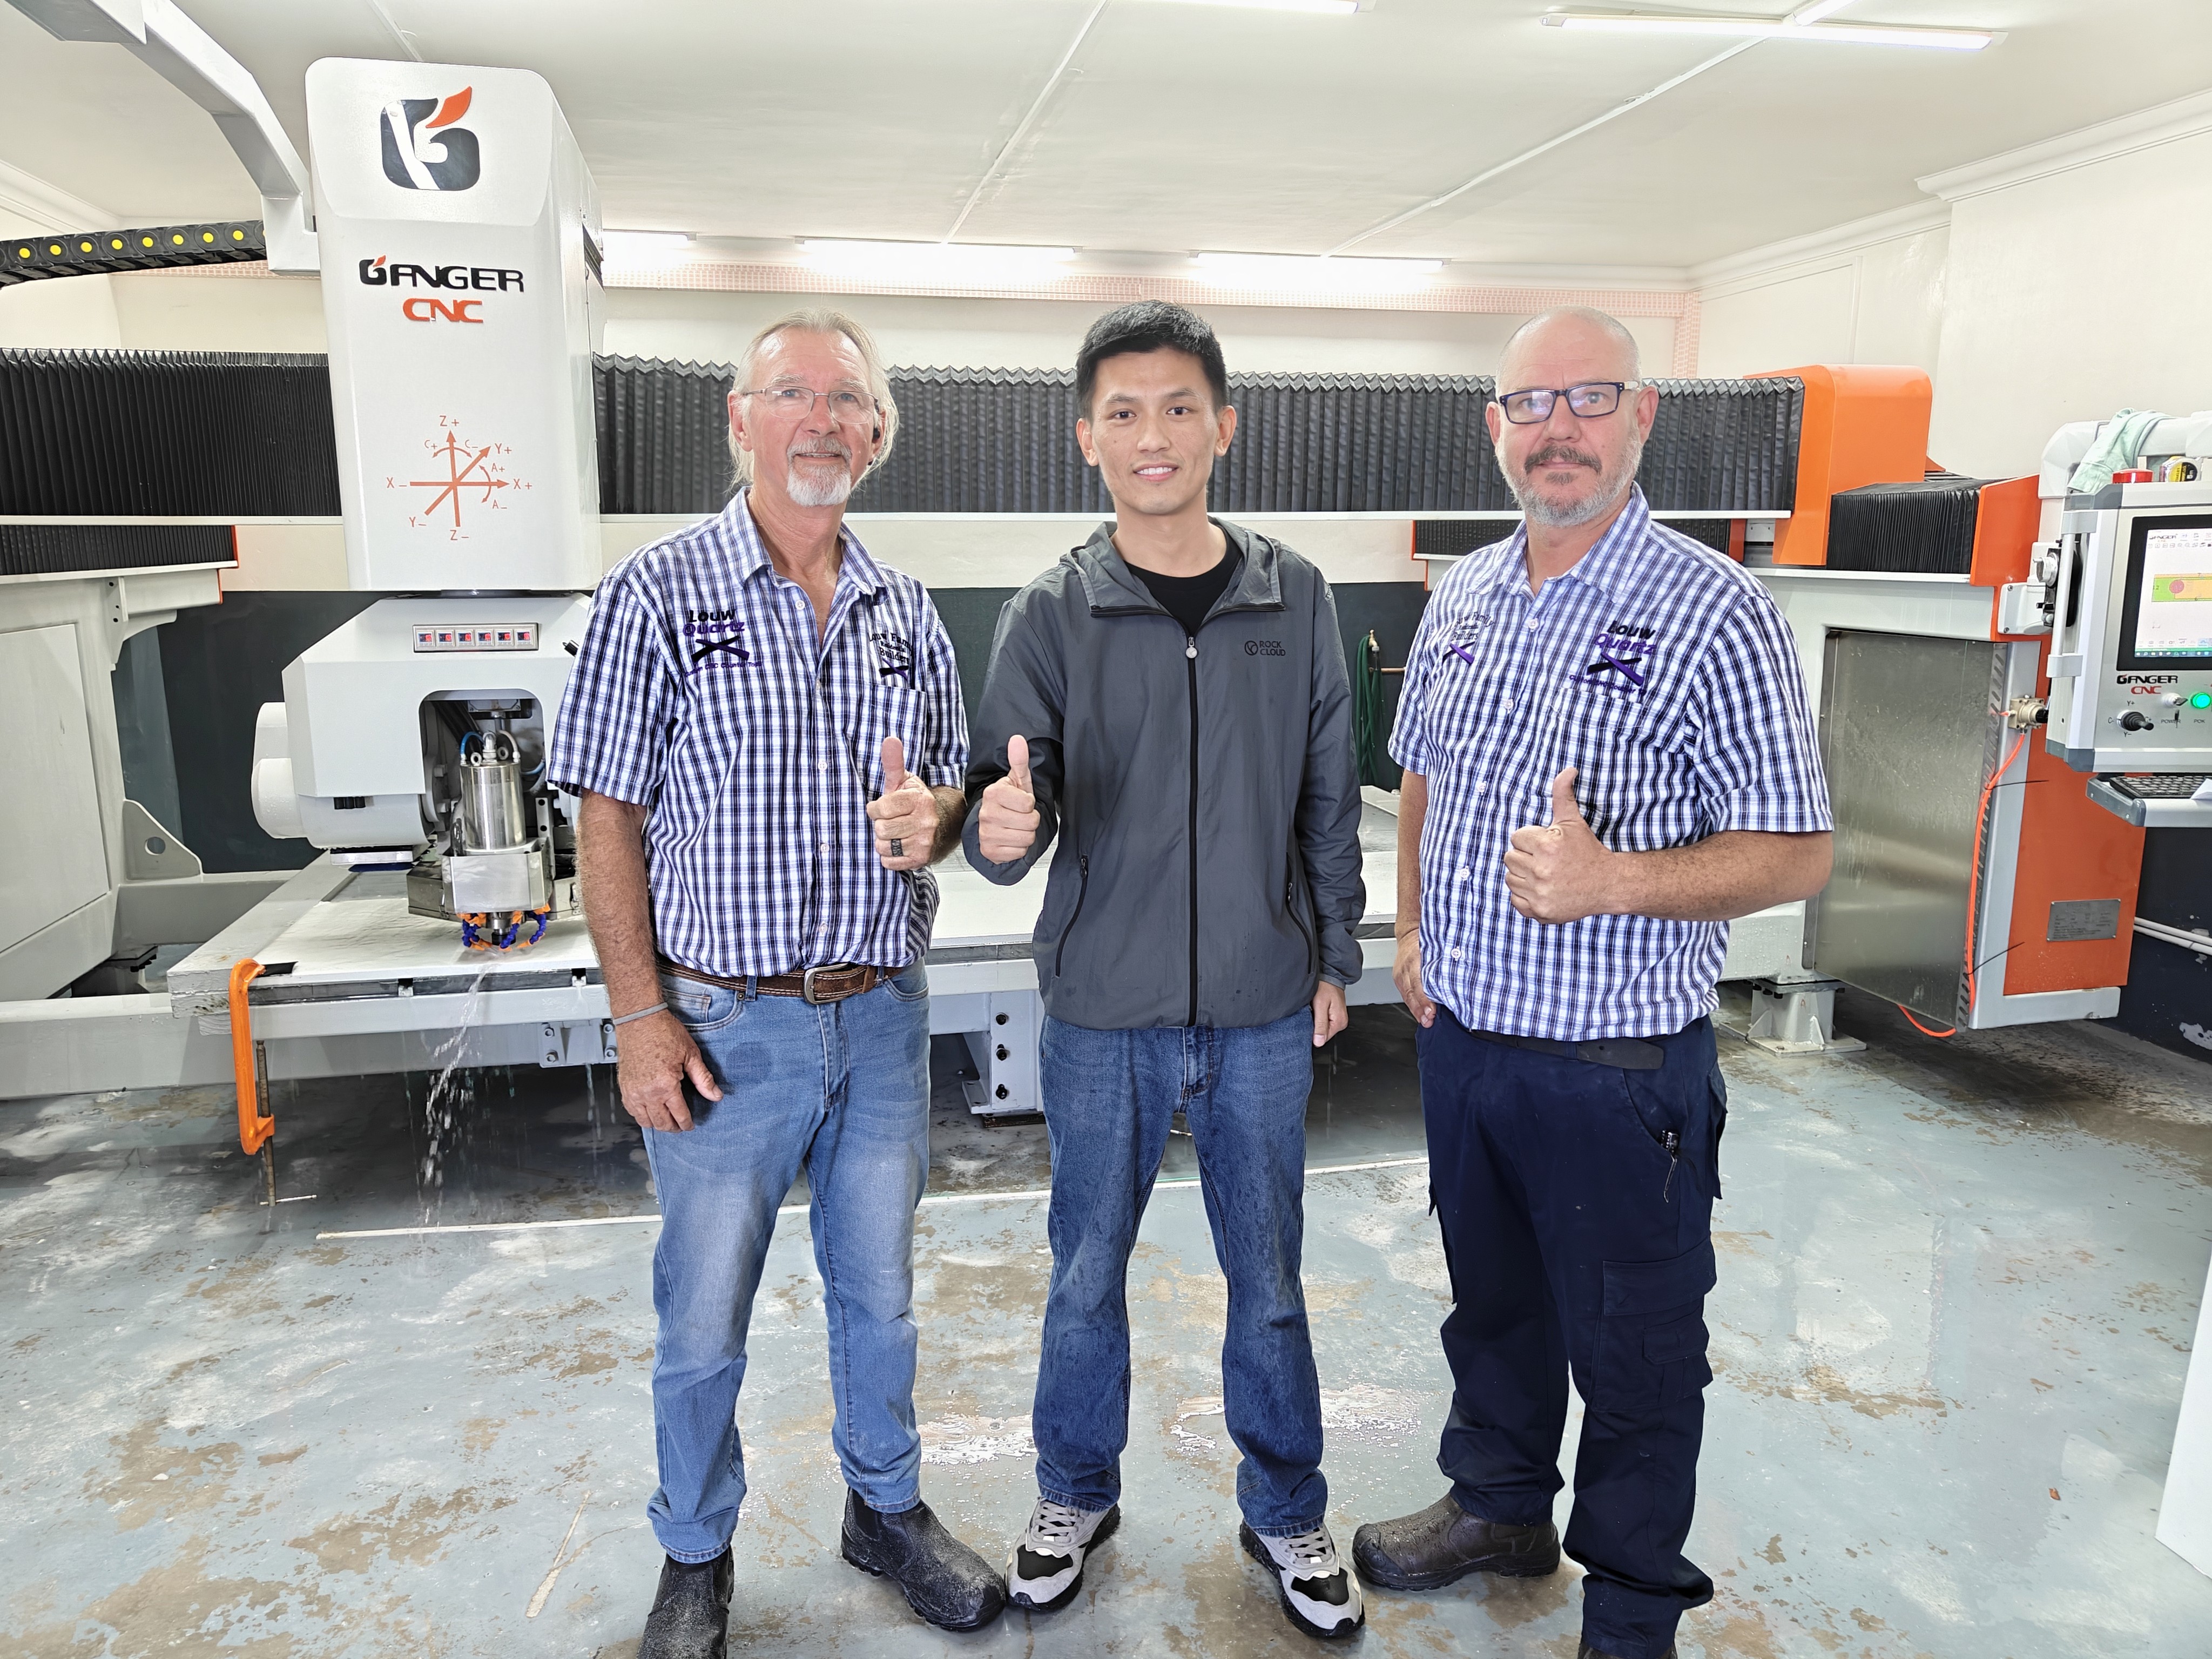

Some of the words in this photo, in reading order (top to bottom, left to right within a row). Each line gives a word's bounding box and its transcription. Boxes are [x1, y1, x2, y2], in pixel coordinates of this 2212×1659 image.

[402, 298, 483, 323] CNC
[683, 621, 745, 637] Quartz
[1451, 631, 1479, 642] Builders
[1259, 640, 1282, 649] ROCK
[1594, 633, 1657, 655] Quartz
[2130, 686, 2162, 694] CNC
